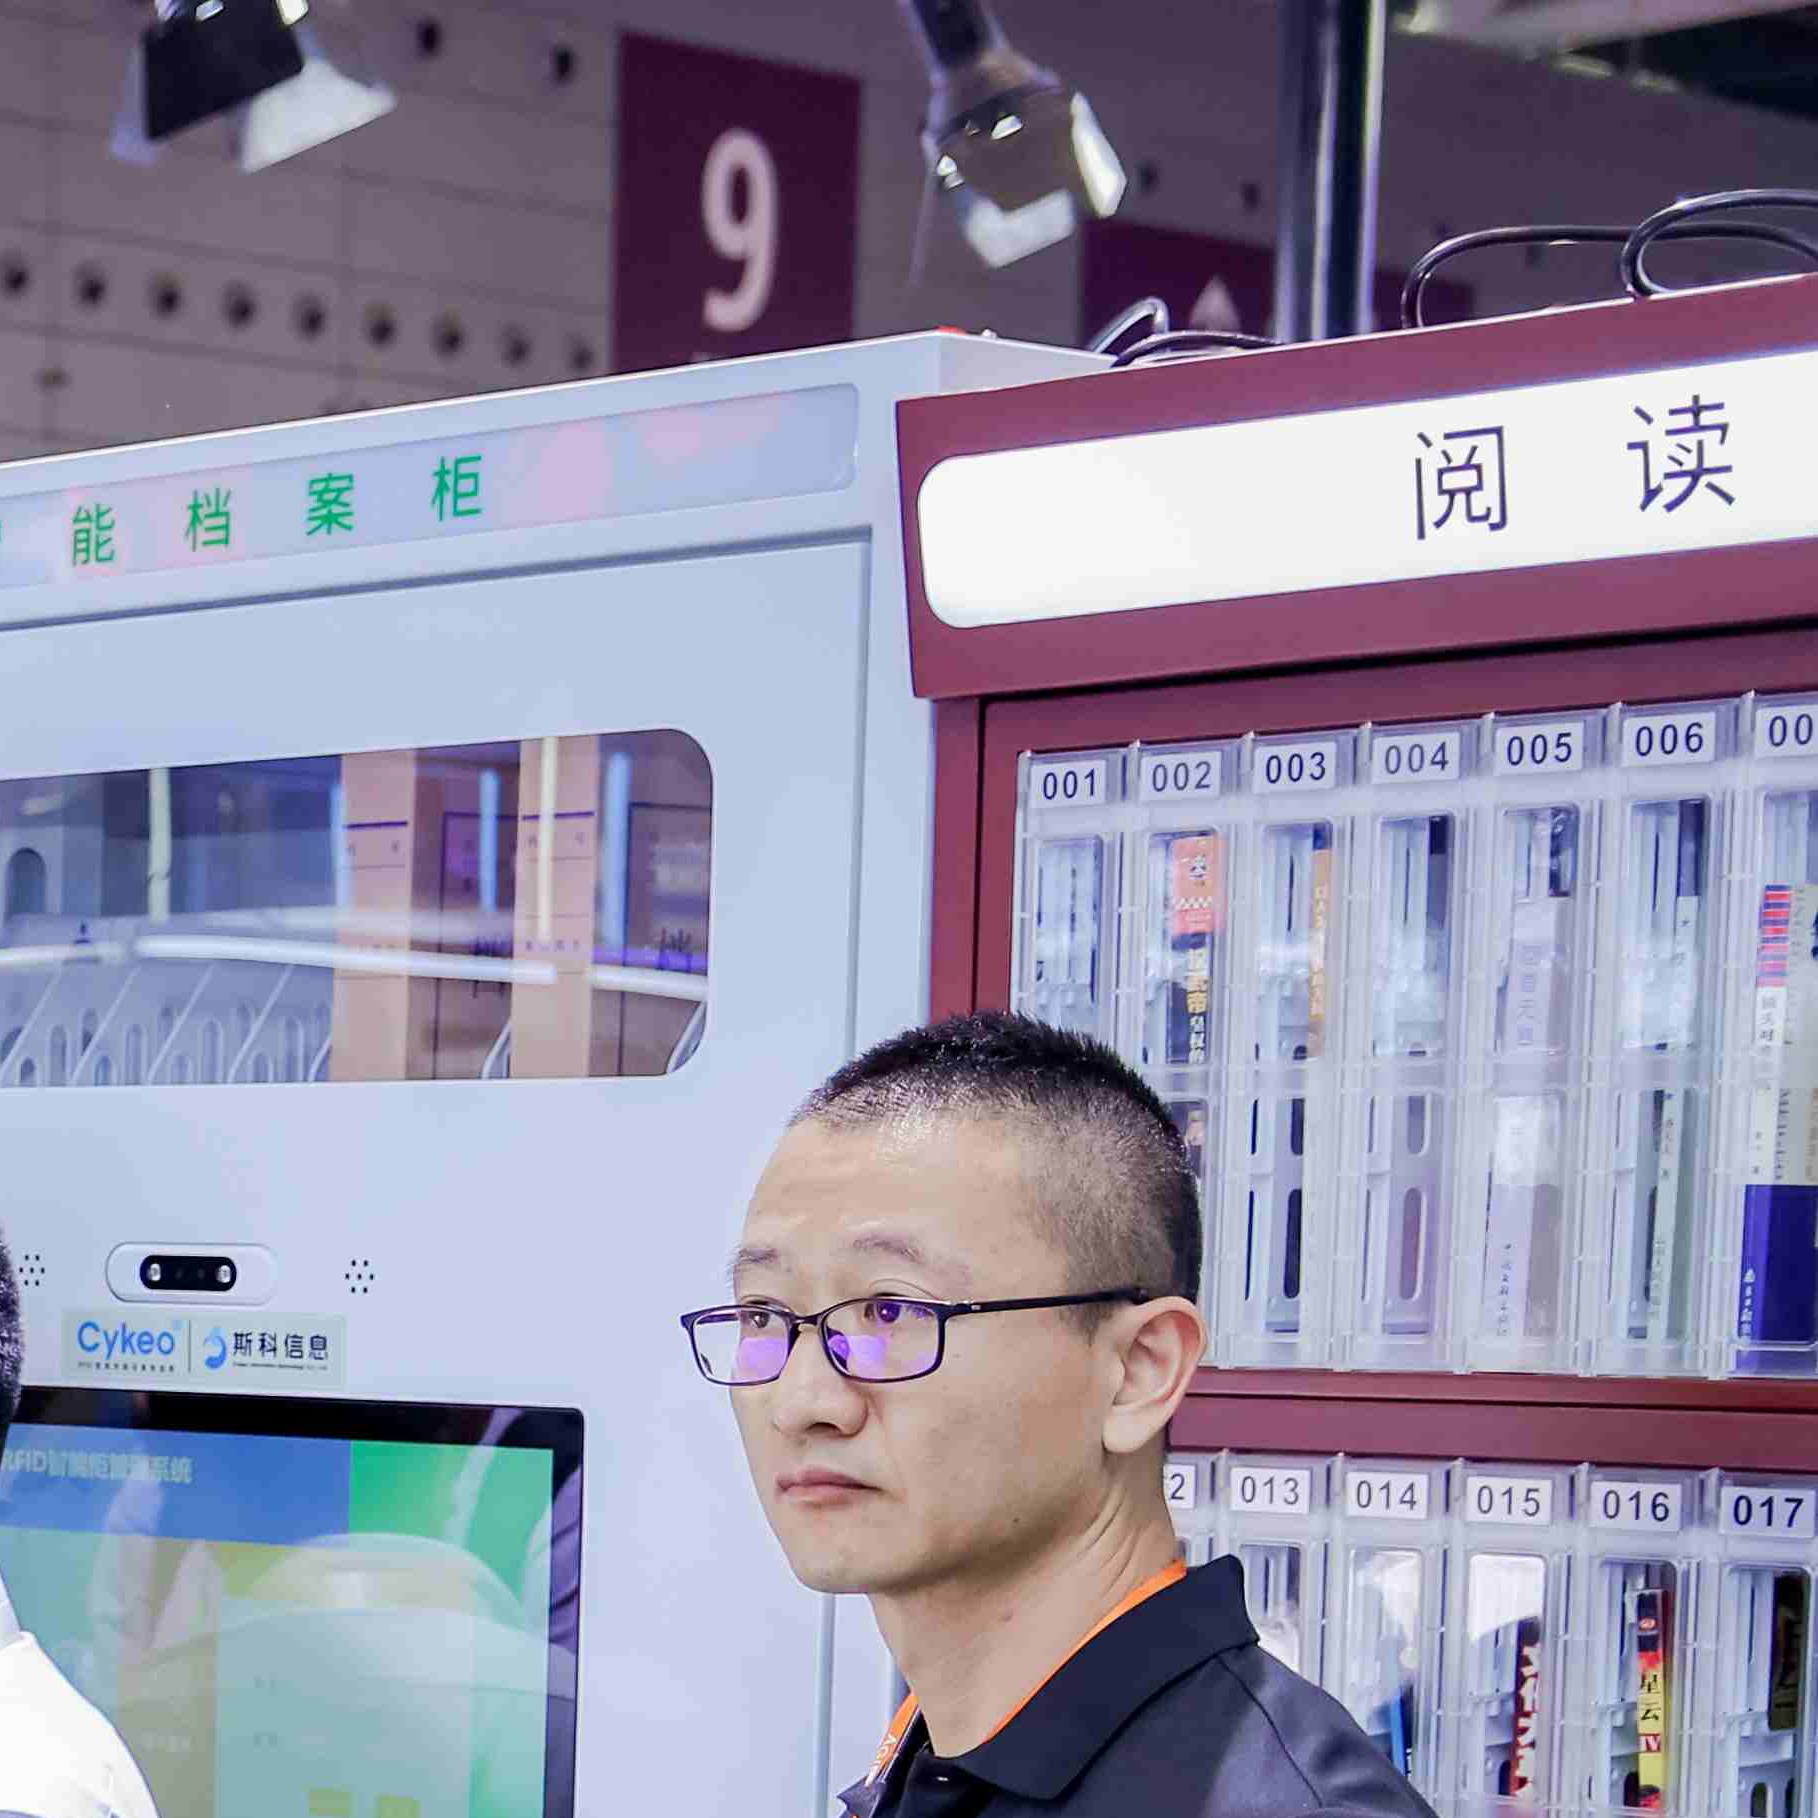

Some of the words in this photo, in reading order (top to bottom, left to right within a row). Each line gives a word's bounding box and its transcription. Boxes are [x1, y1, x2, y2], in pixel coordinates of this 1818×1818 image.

[702, 128, 777, 332] 9
[1415, 394, 1737, 541] 阅读
[1505, 732, 1573, 766] 005
[1633, 722, 1706, 758] 006
[1264, 752, 1327, 785] 003
[1383, 741, 1450, 775] 004
[1041, 769, 1097, 801] 001
[1150, 760, 1213, 793] 002
[76, 1319, 176, 1361] Cykeo
[232, 1330, 329, 1362] 斯科信息
[1240, 1475, 1300, 1506] 013
[1355, 1479, 1418, 1512] 014
[1476, 1484, 1542, 1519] 015
[1601, 1488, 1671, 1524] 016
[1732, 1493, 1805, 1530] 017
